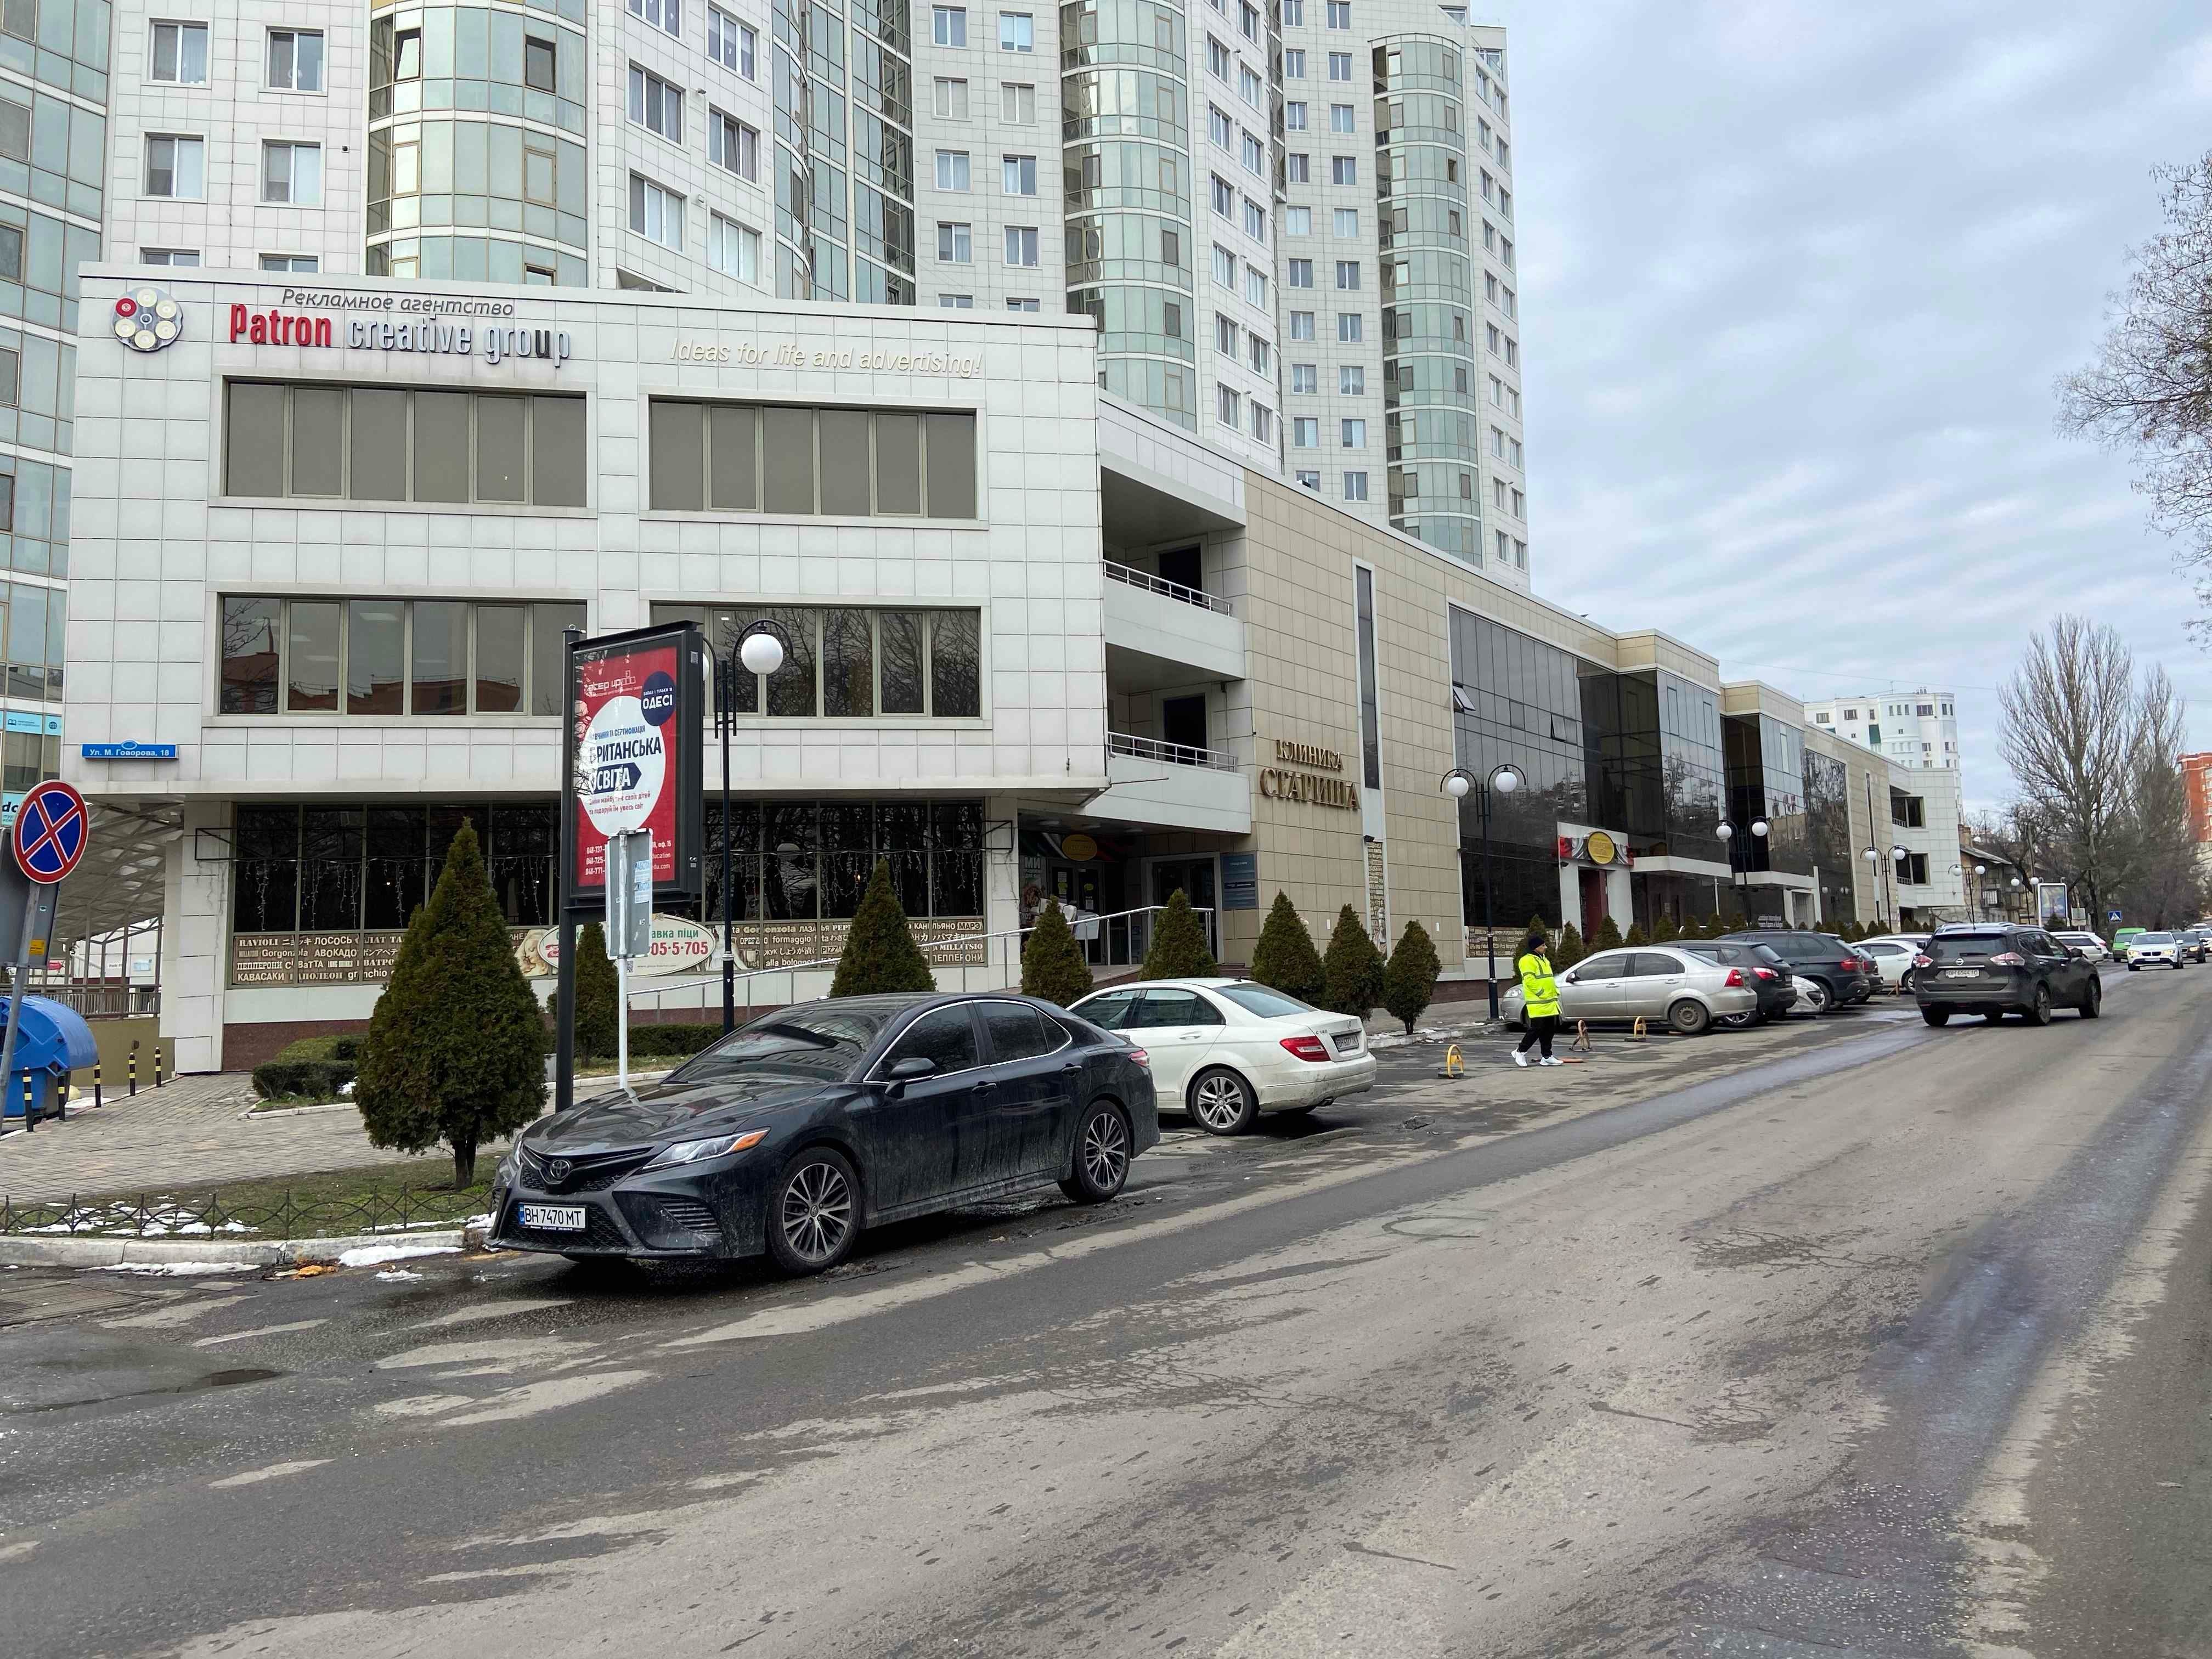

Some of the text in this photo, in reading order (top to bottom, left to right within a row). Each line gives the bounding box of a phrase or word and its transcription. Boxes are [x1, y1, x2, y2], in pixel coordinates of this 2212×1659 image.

[282, 289, 514, 317] Рекламное агентство
[230, 303, 570, 369] Patron creative group
[670, 338, 983, 379] Ideas for life and advertising!
[642, 694, 673, 710] ОДЕСІ
[651, 928, 698, 939] авка піци
[799, 924, 830, 933] ЛАЗАЬЯ
[314, 935, 352, 946] ЛОСОСЬ
[740, 936, 768, 945] ОРЕГАО
[772, 934, 829, 945] formaggio fta
[262, 948, 308, 959] Gorgonzla
[314, 948, 357, 958] АВОКАДО
[237, 961, 283, 970] ПЕППЕРОНИ
[765, 958, 779, 967] alla
[238, 972, 284, 981] КАВАСАКИ
[348, 968, 387, 981] grnchio
[524, 1207, 539, 1223] BH
[540, 1209, 563, 1224] 7470
[566, 1210, 582, 1226] MT
